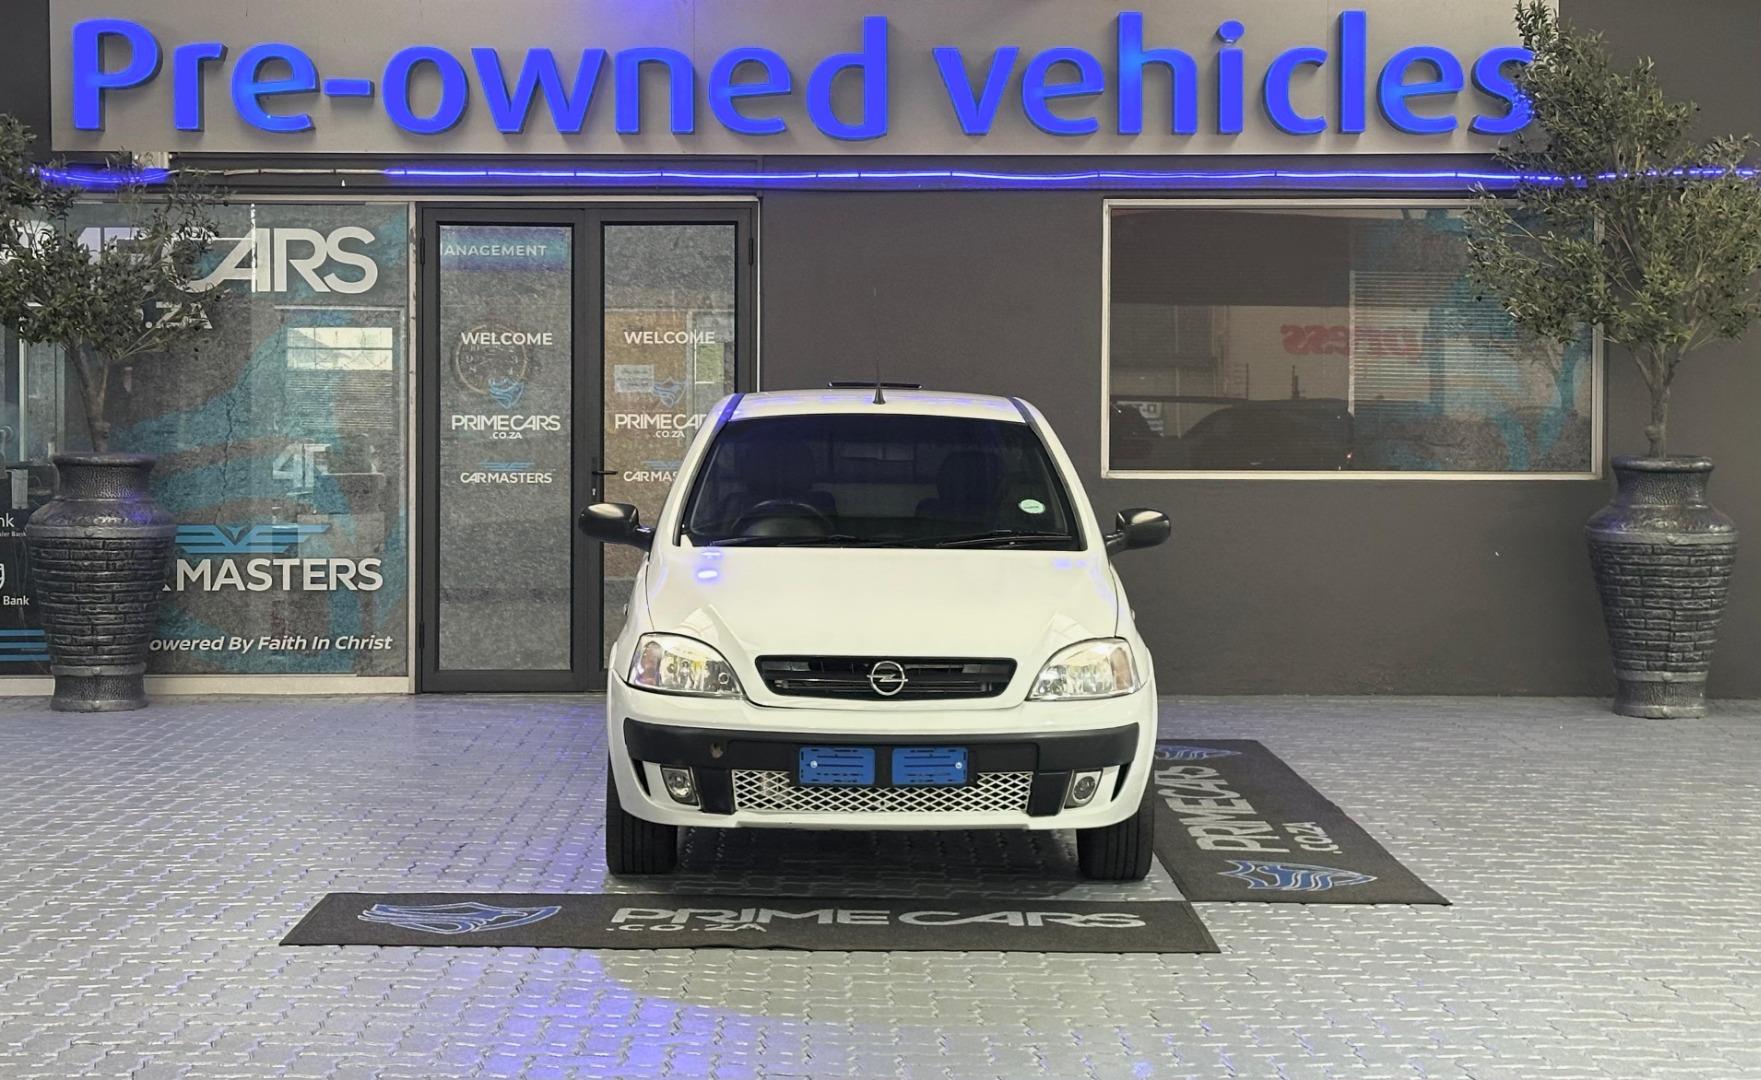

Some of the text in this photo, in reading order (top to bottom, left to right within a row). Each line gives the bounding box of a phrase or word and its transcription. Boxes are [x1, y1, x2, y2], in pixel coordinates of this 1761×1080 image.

[72, 10, 1535, 141] Pre-owned vehicles
[440, 244, 547, 257] ANAGEMENT
[461, 332, 553, 345] WELCOME
[624, 331, 716, 345] WELCOME
[451, 414, 561, 431] PRIMECARS
[460, 472, 553, 484] CARMASTERS
[162, 558, 384, 592] MASTERS
[3, 595, 30, 606] Bank
[148, 634, 393, 655] owered By Faith In Christ
